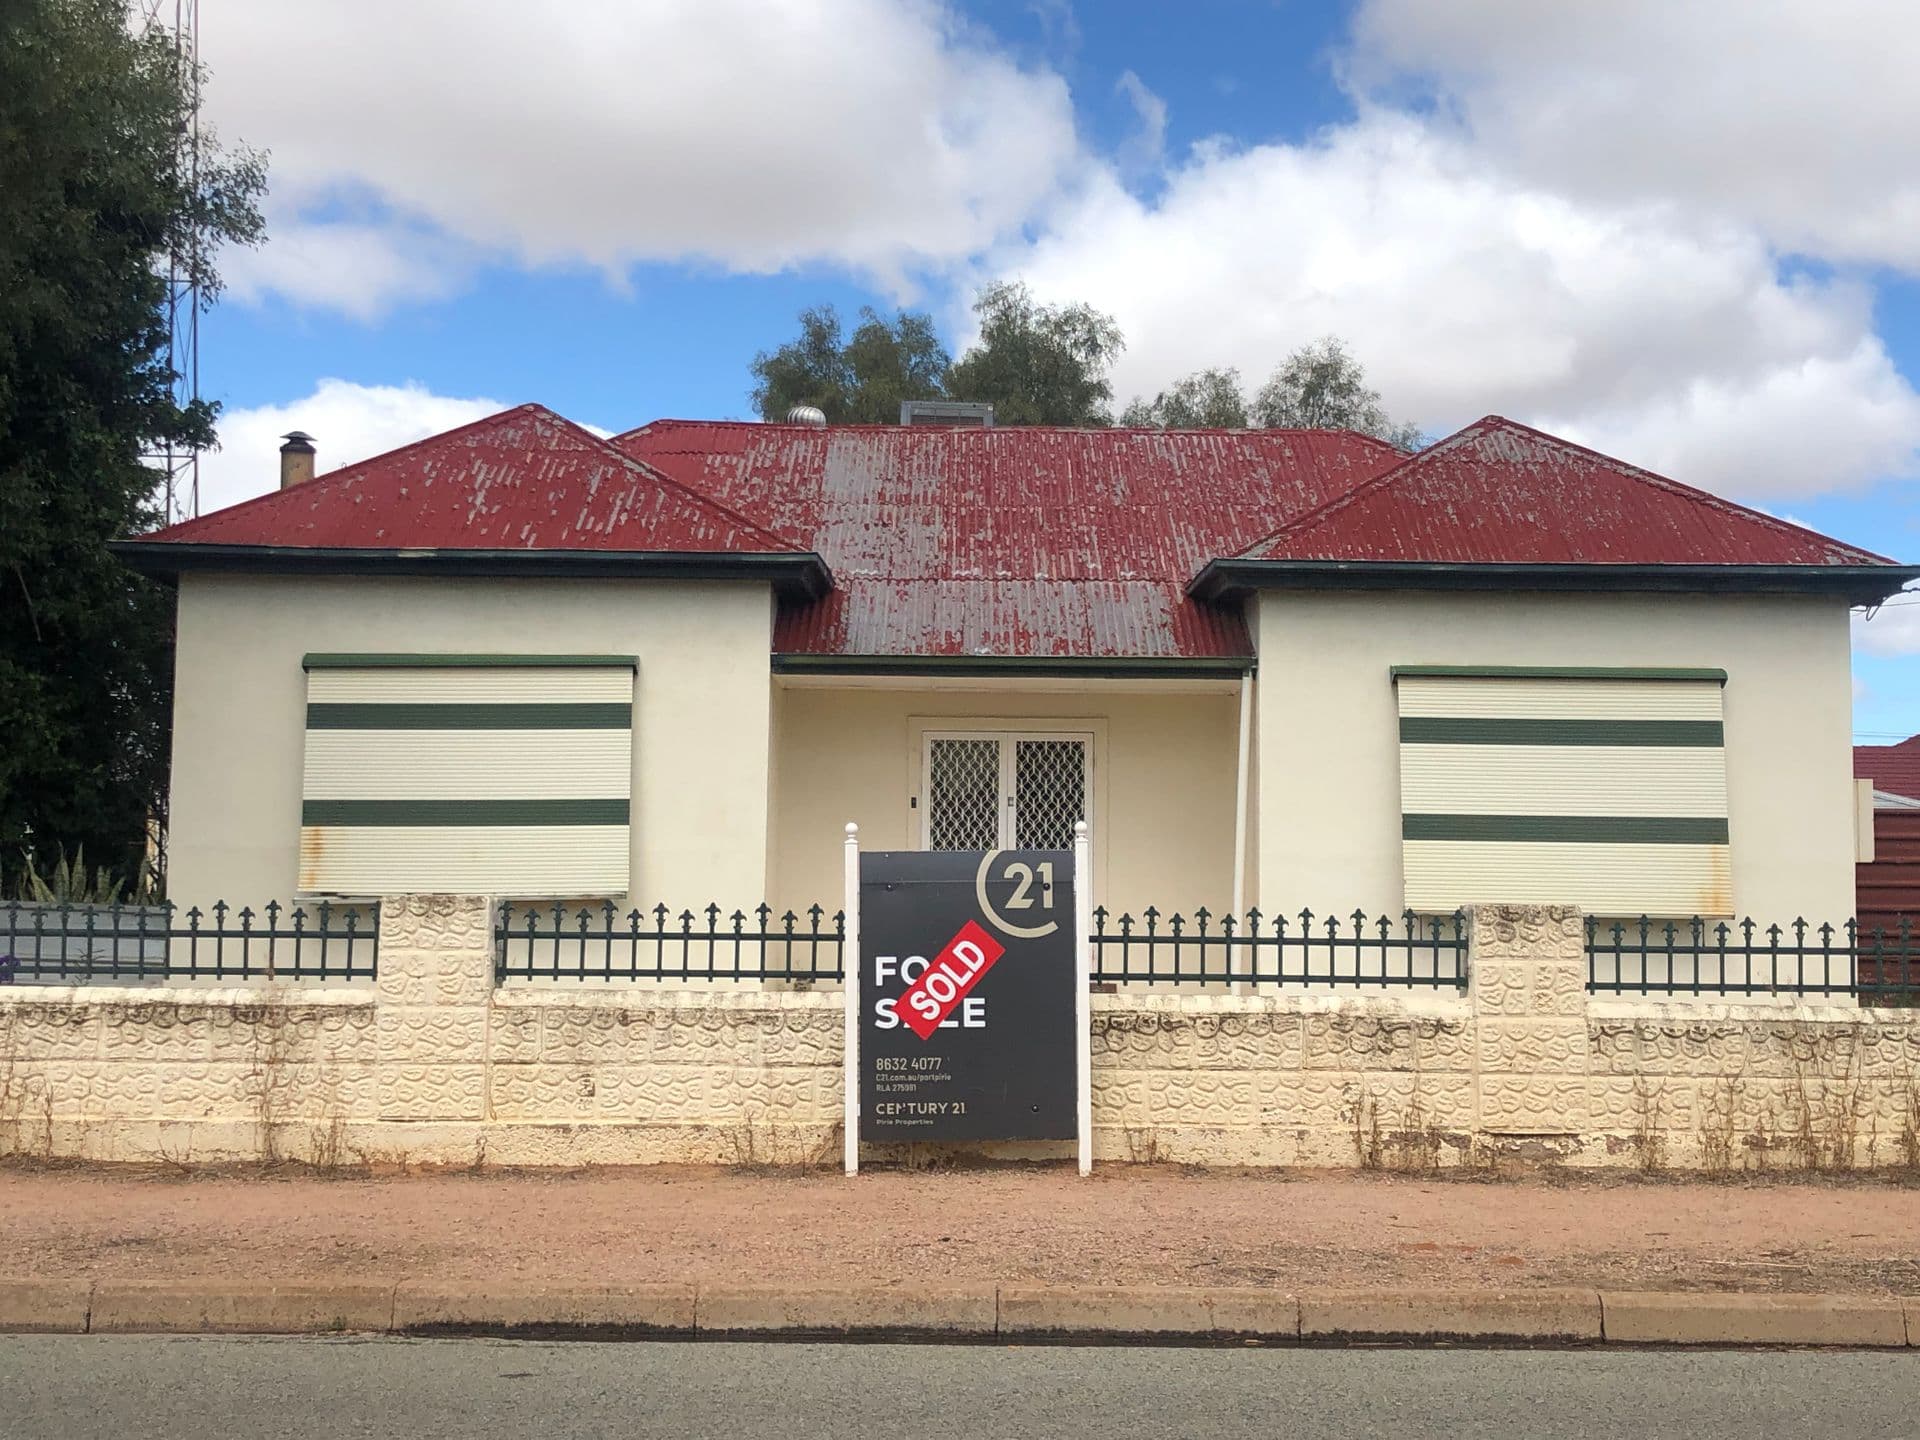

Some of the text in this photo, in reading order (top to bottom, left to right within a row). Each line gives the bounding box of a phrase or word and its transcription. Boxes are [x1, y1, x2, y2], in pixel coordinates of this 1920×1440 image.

[1003, 862, 1054, 909] 21
[875, 955, 931, 986] FO
[910, 940, 985, 1021] SOLD
[874, 997, 986, 1029] SE
[876, 1057, 942, 1071] 8632 4077
[876, 1083, 891, 1092] RLA
[875, 1102, 966, 1115] CENTURY 21
